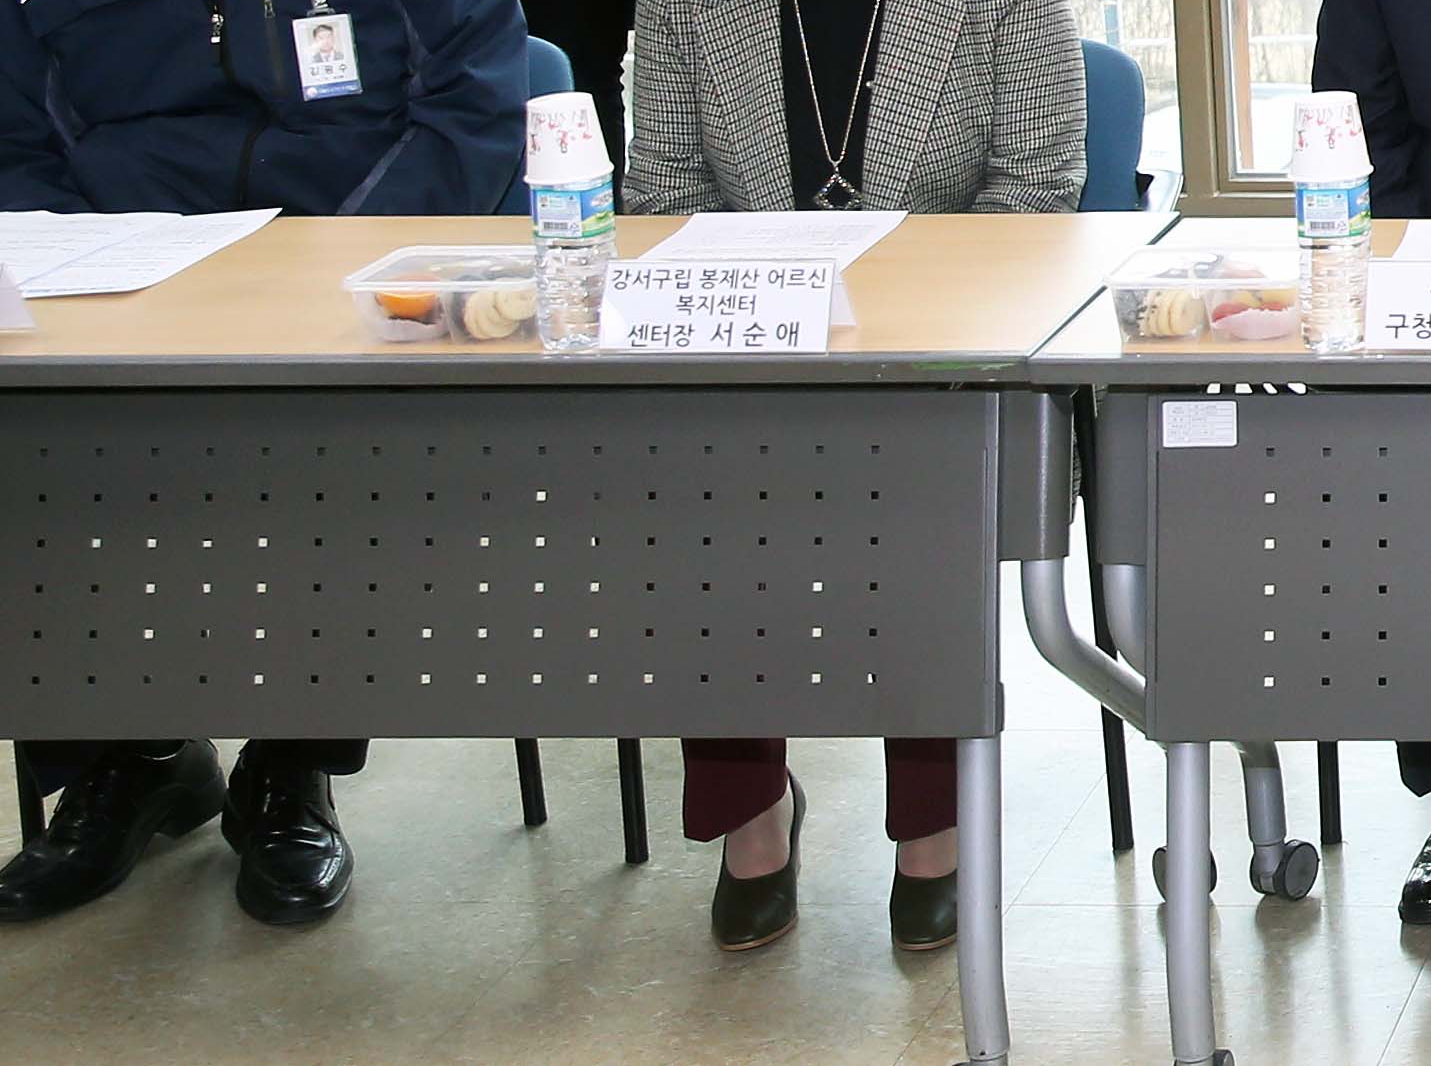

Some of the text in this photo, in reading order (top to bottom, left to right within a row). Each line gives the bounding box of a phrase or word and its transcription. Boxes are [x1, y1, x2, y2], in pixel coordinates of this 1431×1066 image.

[613, 269, 825, 290] 강서구립 봉제산 어르신
[676, 295, 756, 315] 복지센터
[628, 324, 694, 347] 센터장
